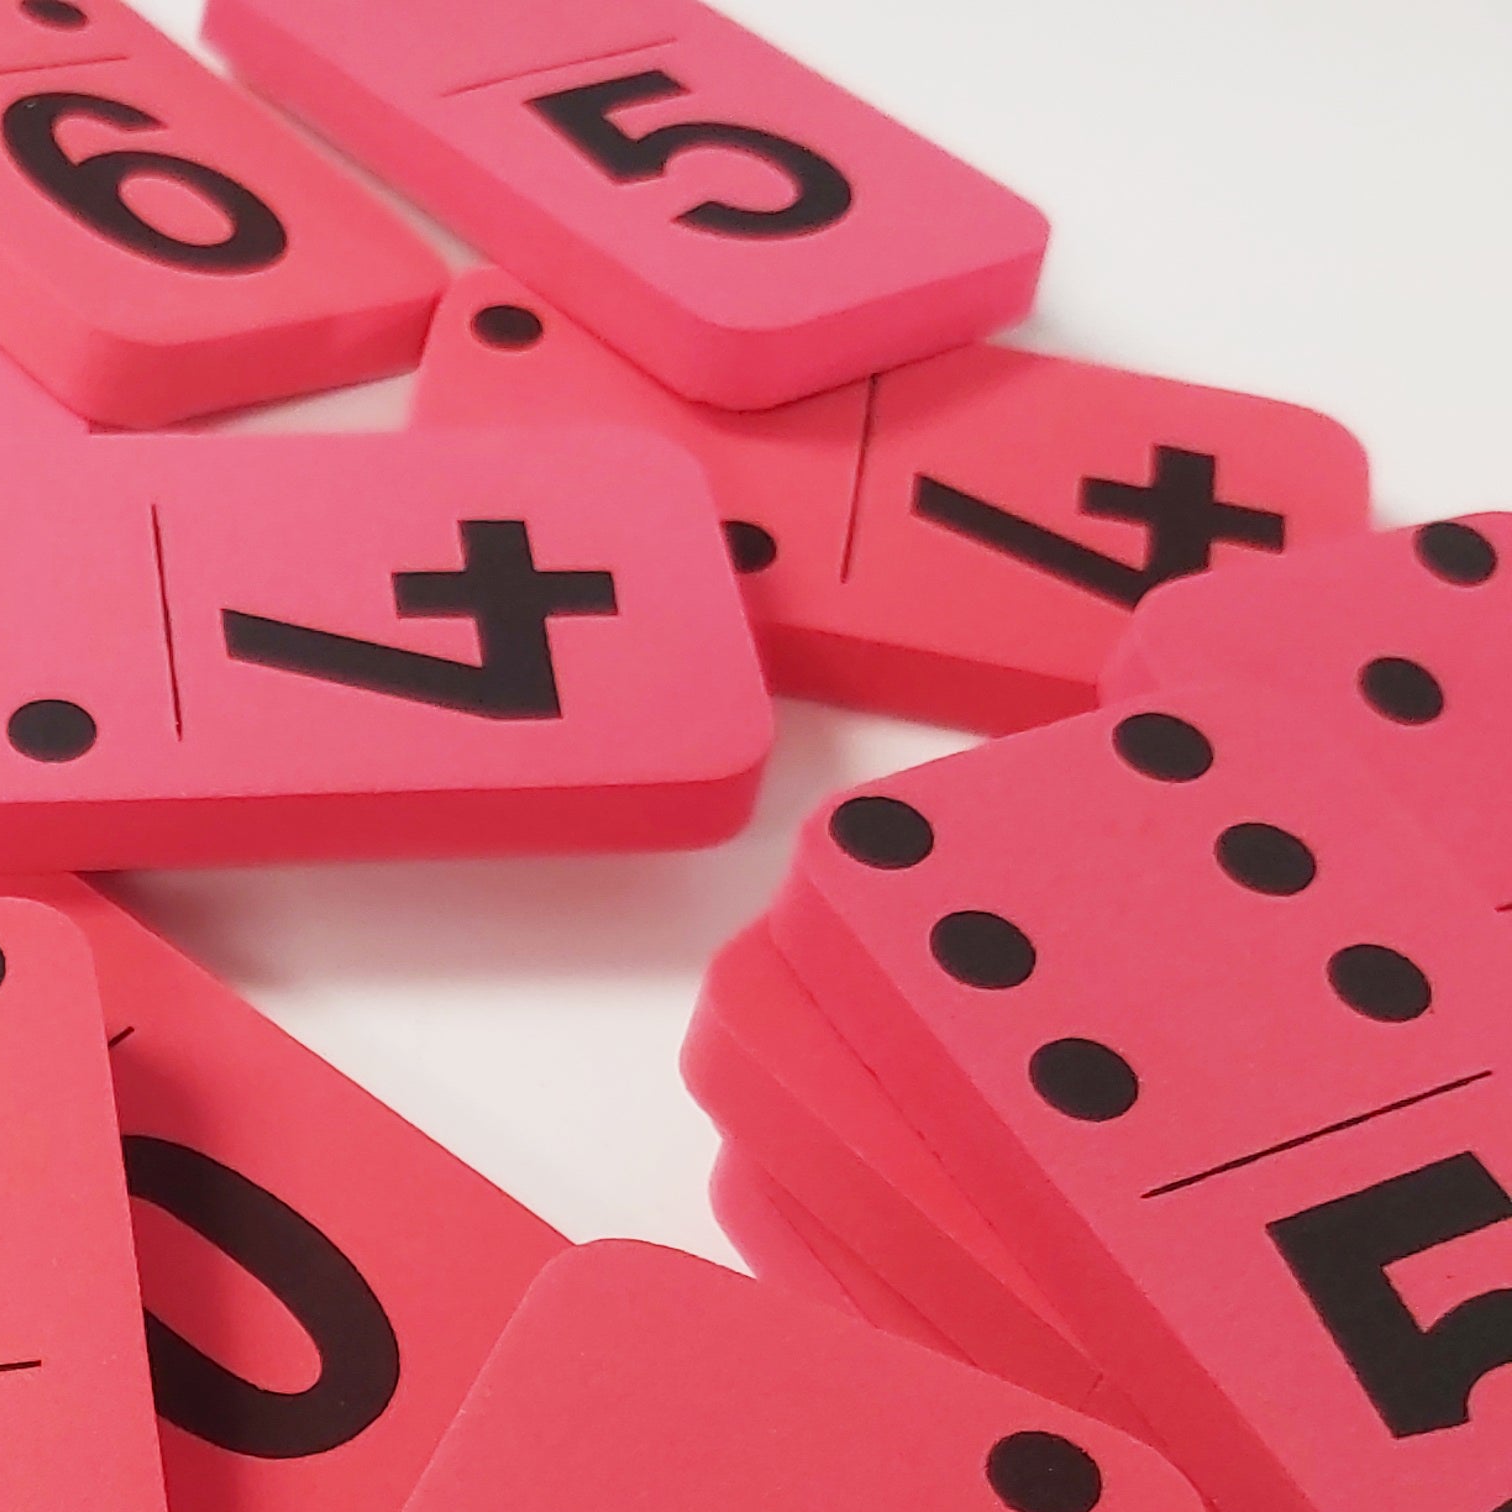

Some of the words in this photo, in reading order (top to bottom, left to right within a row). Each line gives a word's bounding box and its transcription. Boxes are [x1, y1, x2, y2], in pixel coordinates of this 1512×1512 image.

[1, 90, 289, 275] 6
[528, 69, 853, 241] 5
[910, 443, 1285, 612] 4
[221, 518, 617, 720] 4
